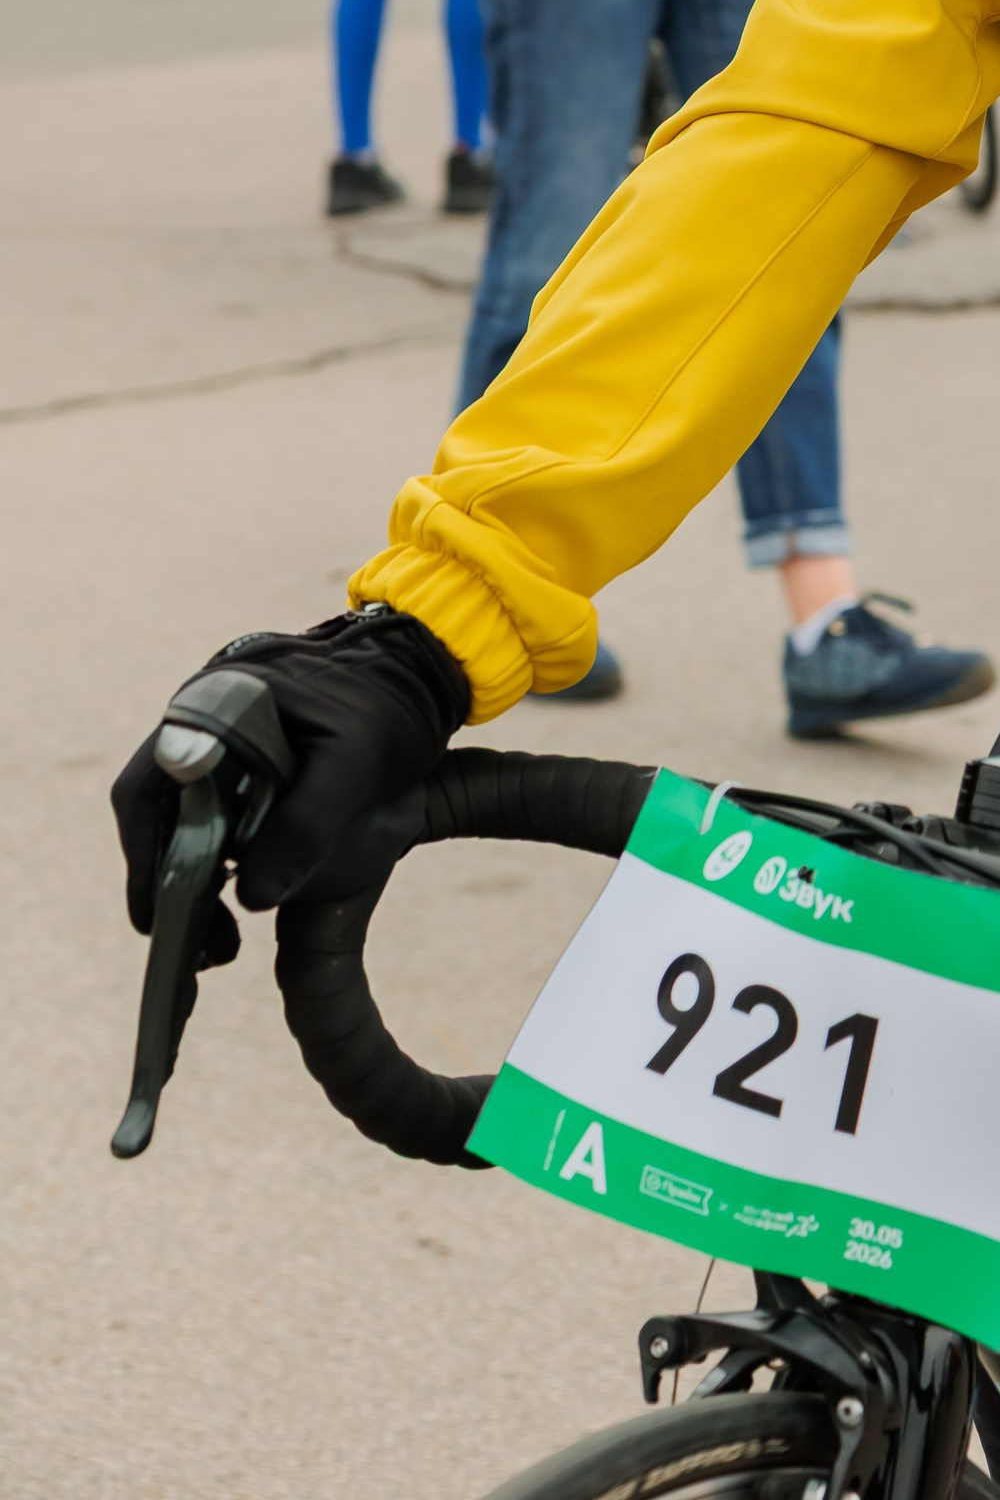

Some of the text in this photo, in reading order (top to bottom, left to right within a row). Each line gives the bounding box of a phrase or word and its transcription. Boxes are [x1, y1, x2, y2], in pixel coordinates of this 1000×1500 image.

[645, 952, 880, 1137] 921
[558, 1120, 608, 1196] A
[842, 1240, 893, 1270] 2026
[848, 1217, 904, 1249] 30.05
